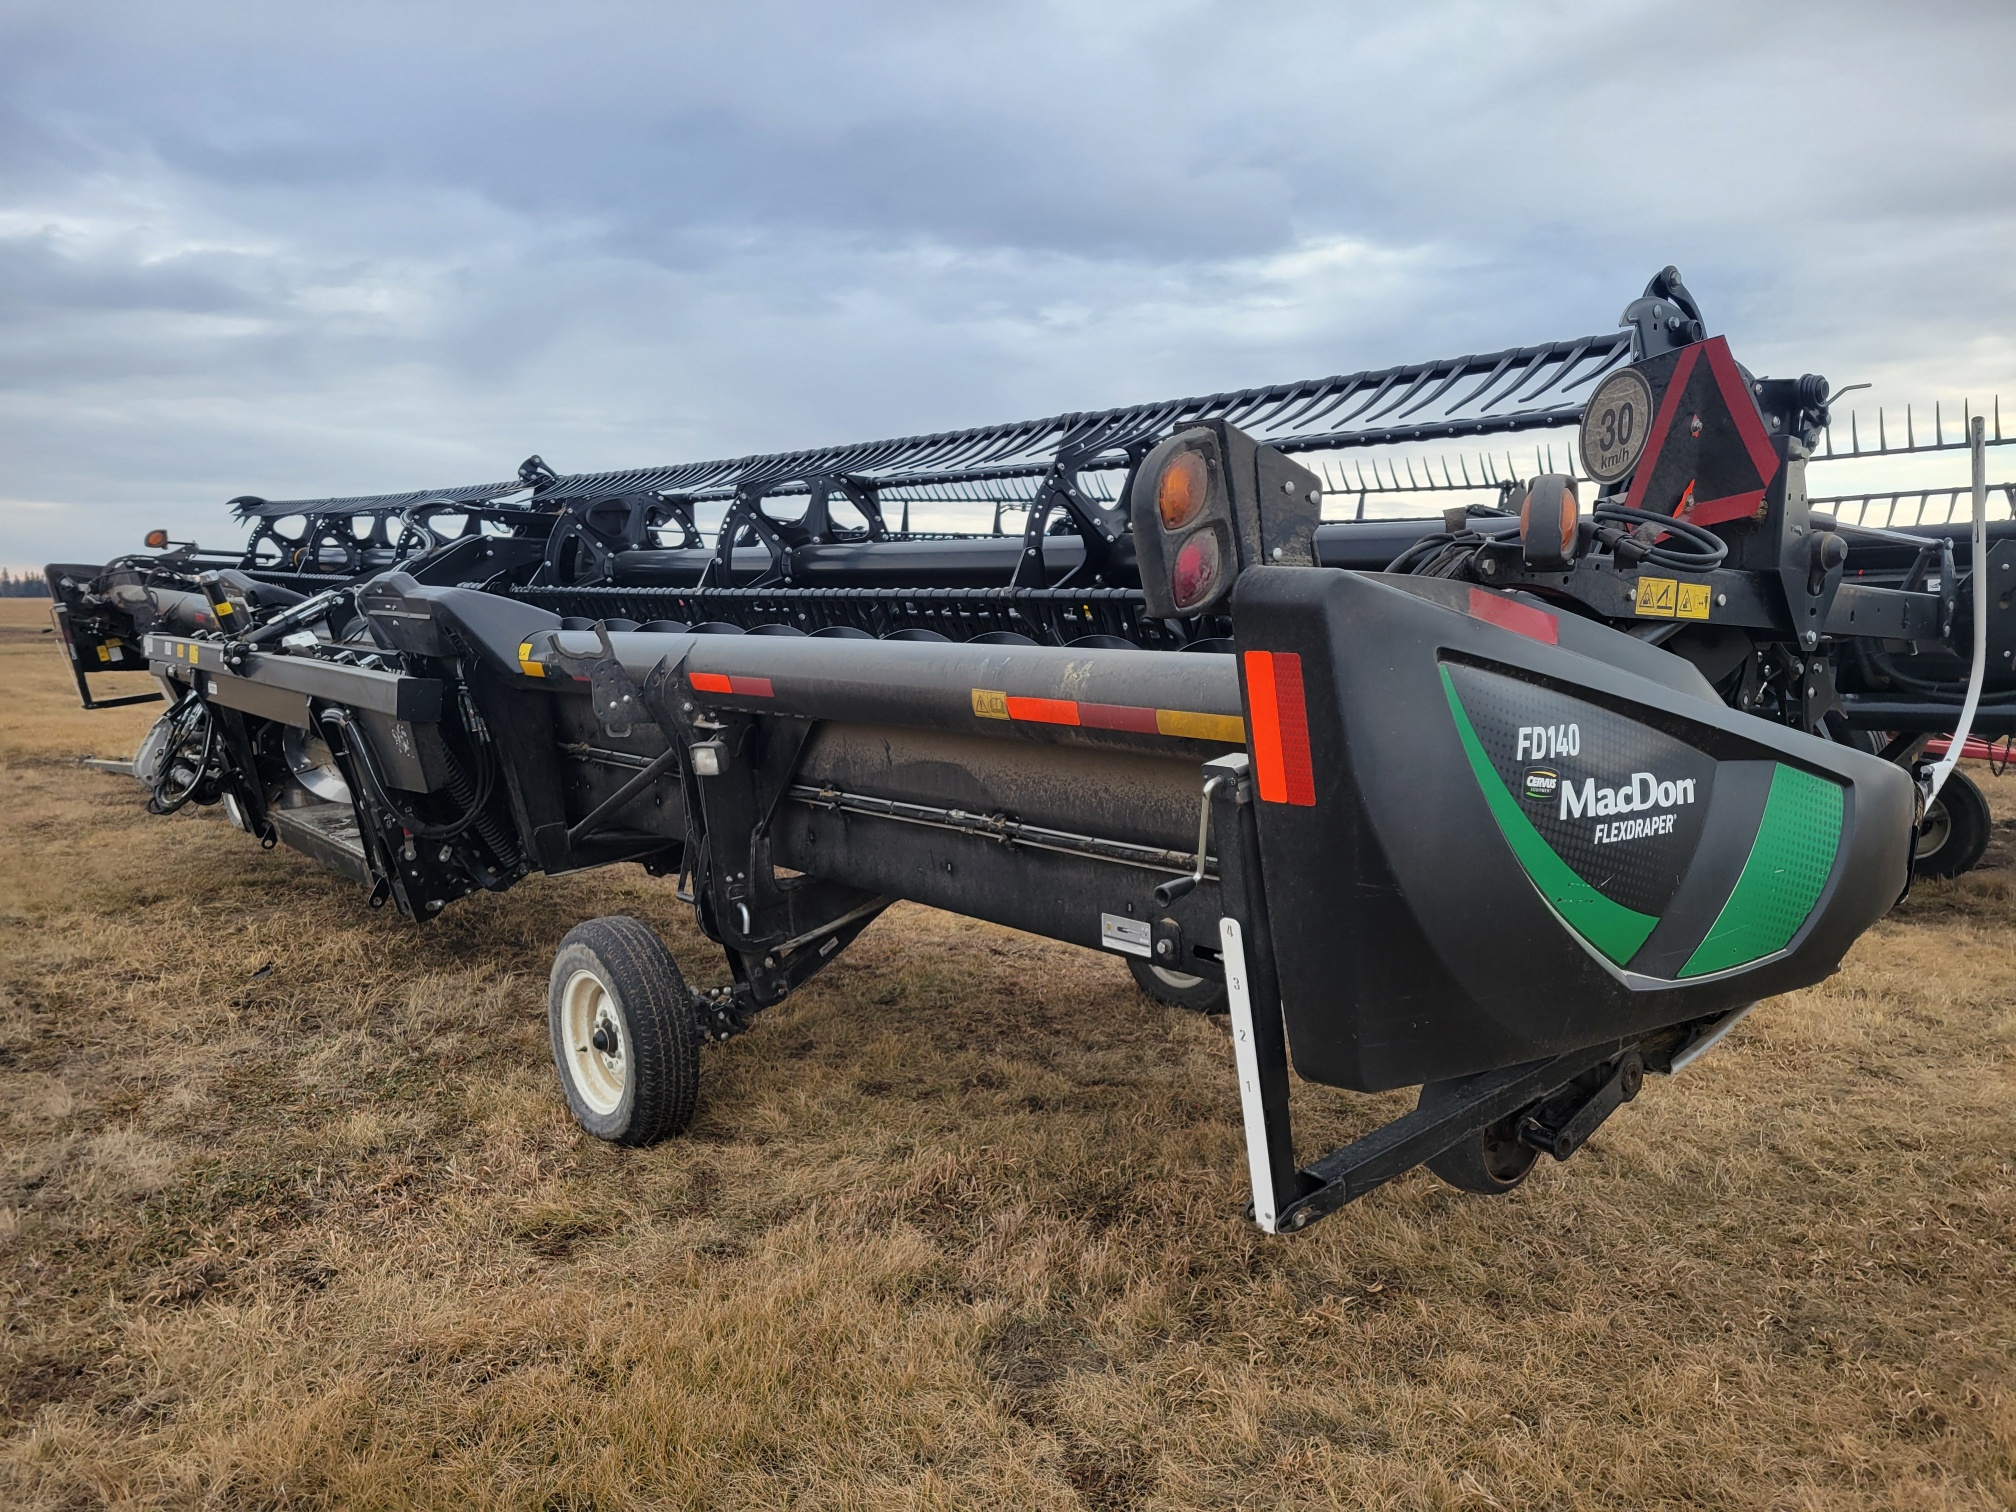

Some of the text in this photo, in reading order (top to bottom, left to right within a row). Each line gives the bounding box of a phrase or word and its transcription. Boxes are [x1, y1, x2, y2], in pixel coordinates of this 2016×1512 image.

[1600, 402, 1633, 452] 30
[1601, 447, 1629, 470] km/h
[1516, 723, 1580, 761] FD140
[1526, 775, 1557, 789] CERVUS
[1560, 772, 1695, 820] MacDon
[1594, 815, 1676, 844] FLEXDRAPER
[1226, 924, 1234, 937] 4
[1233, 977, 1241, 991] 3
[1240, 1029, 1247, 1042] 2
[1246, 1081, 1251, 1092] 1
